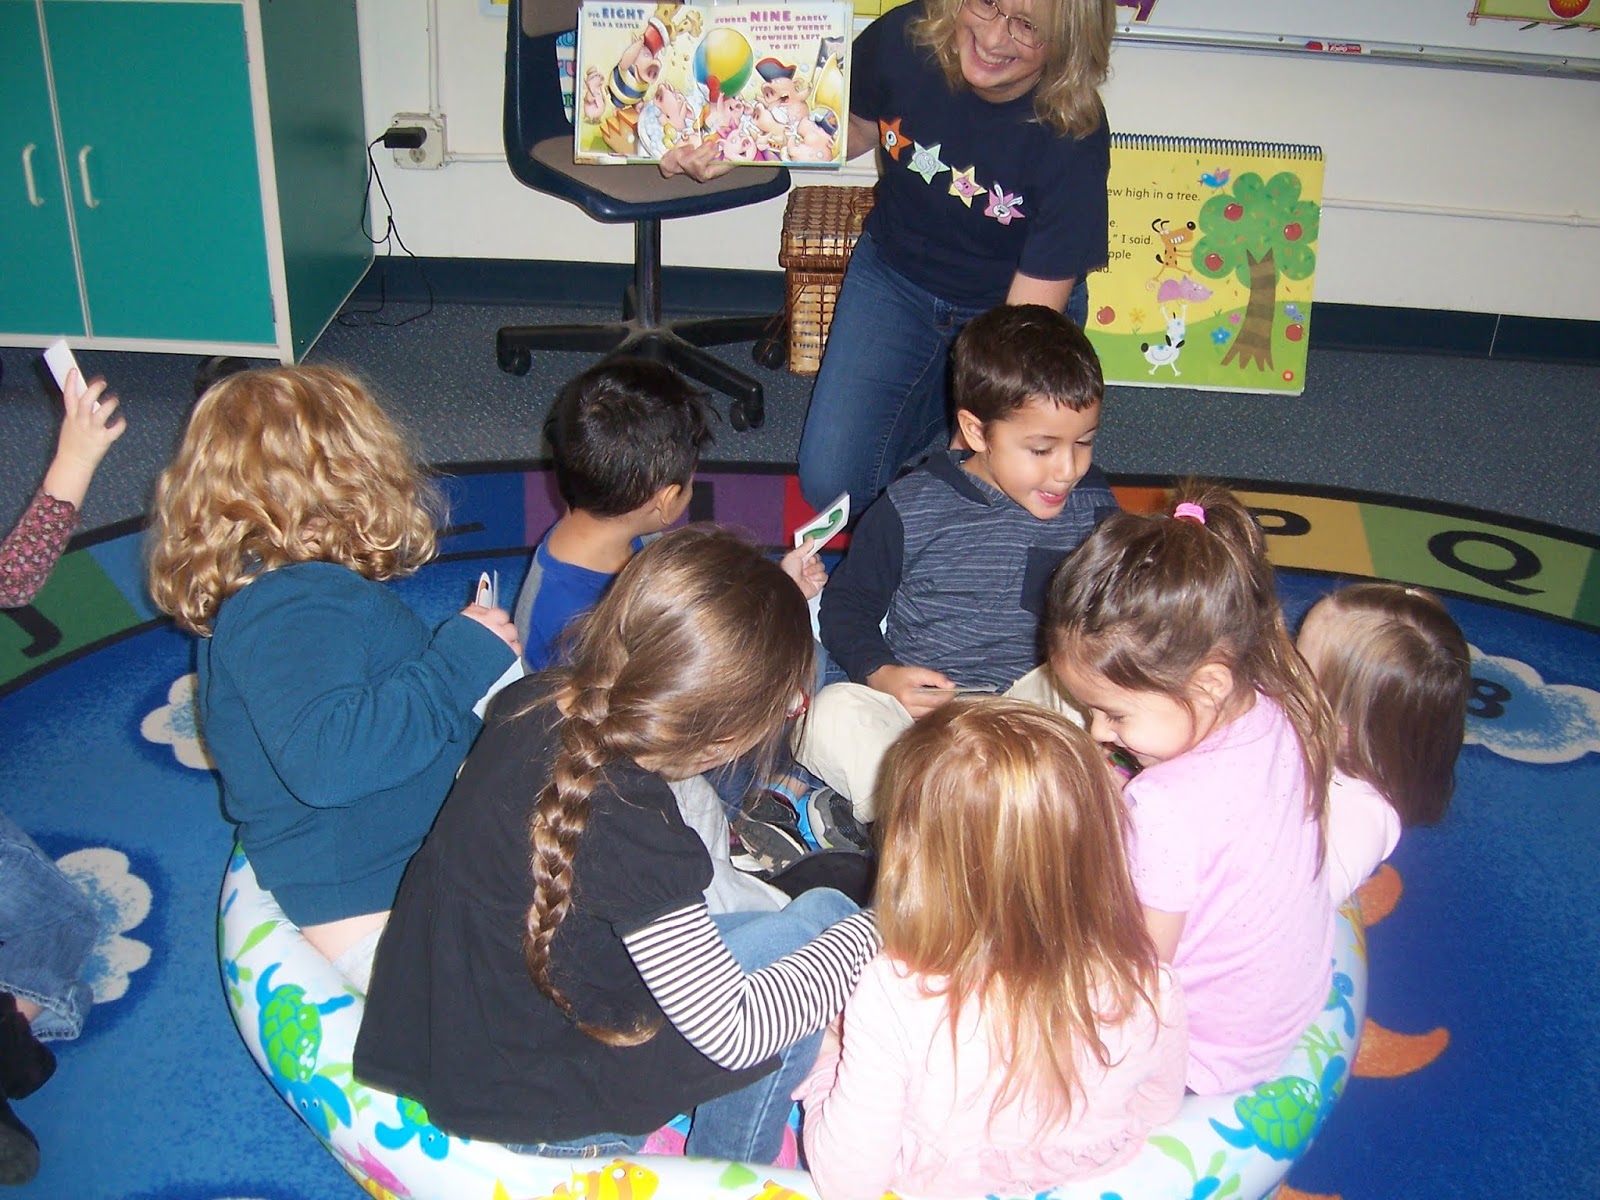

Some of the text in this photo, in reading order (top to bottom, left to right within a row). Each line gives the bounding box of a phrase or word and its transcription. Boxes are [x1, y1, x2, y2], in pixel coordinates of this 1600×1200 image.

[602, 7, 645, 20] EIGHT
[750, 11, 792, 23] NINE
[801, 33, 821, 41] LEFT
[1125, 187, 1150, 200] high
[1153, 189, 1164, 199] in
[1166, 192, 1174, 200] a
[1177, 192, 1201, 202] tree.
[1121, 234, 1127, 244] I
[1129, 235, 1154, 246] said.
[1428, 531, 1545, 595] Q
[1466, 678, 1512, 718] 8
